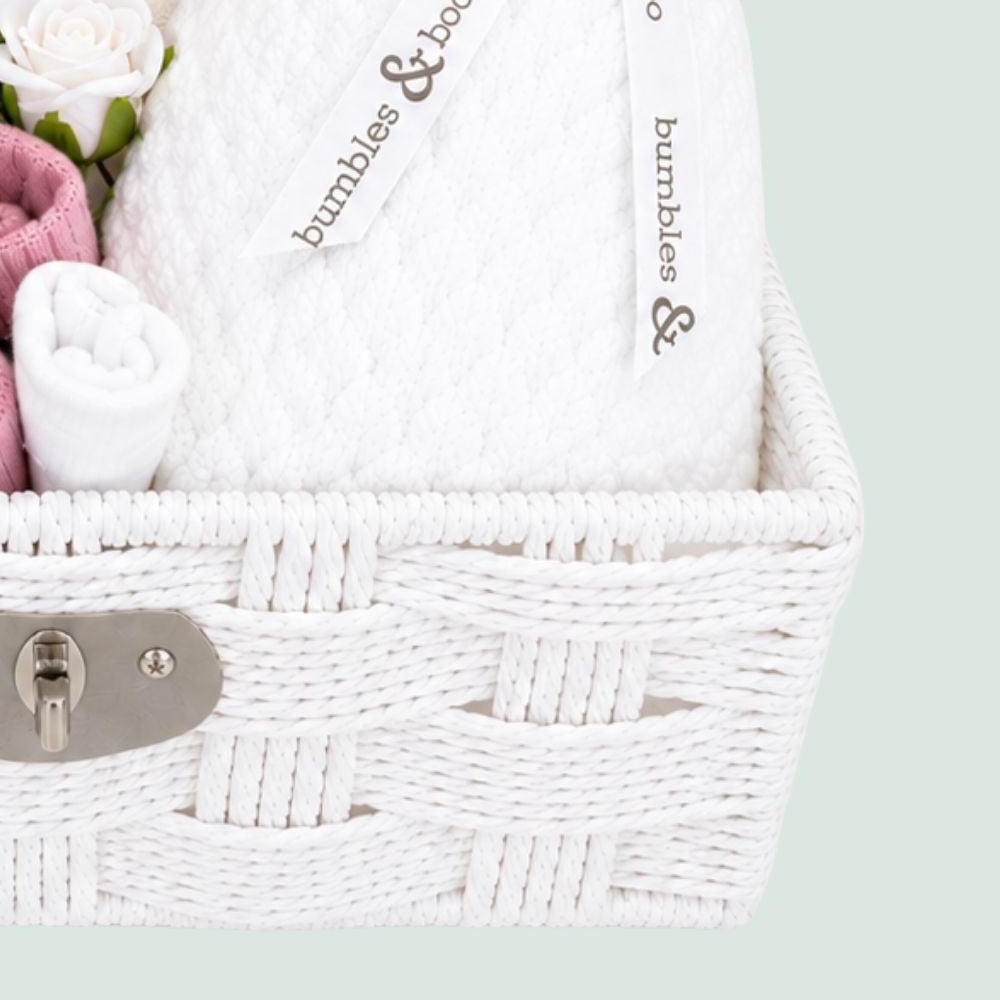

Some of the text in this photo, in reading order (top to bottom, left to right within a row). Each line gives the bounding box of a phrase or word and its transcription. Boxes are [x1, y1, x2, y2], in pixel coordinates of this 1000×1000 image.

[291, 103, 400, 250] bumbles
[379, 47, 446, 103] &
[651, 115, 696, 356] bumbles &
